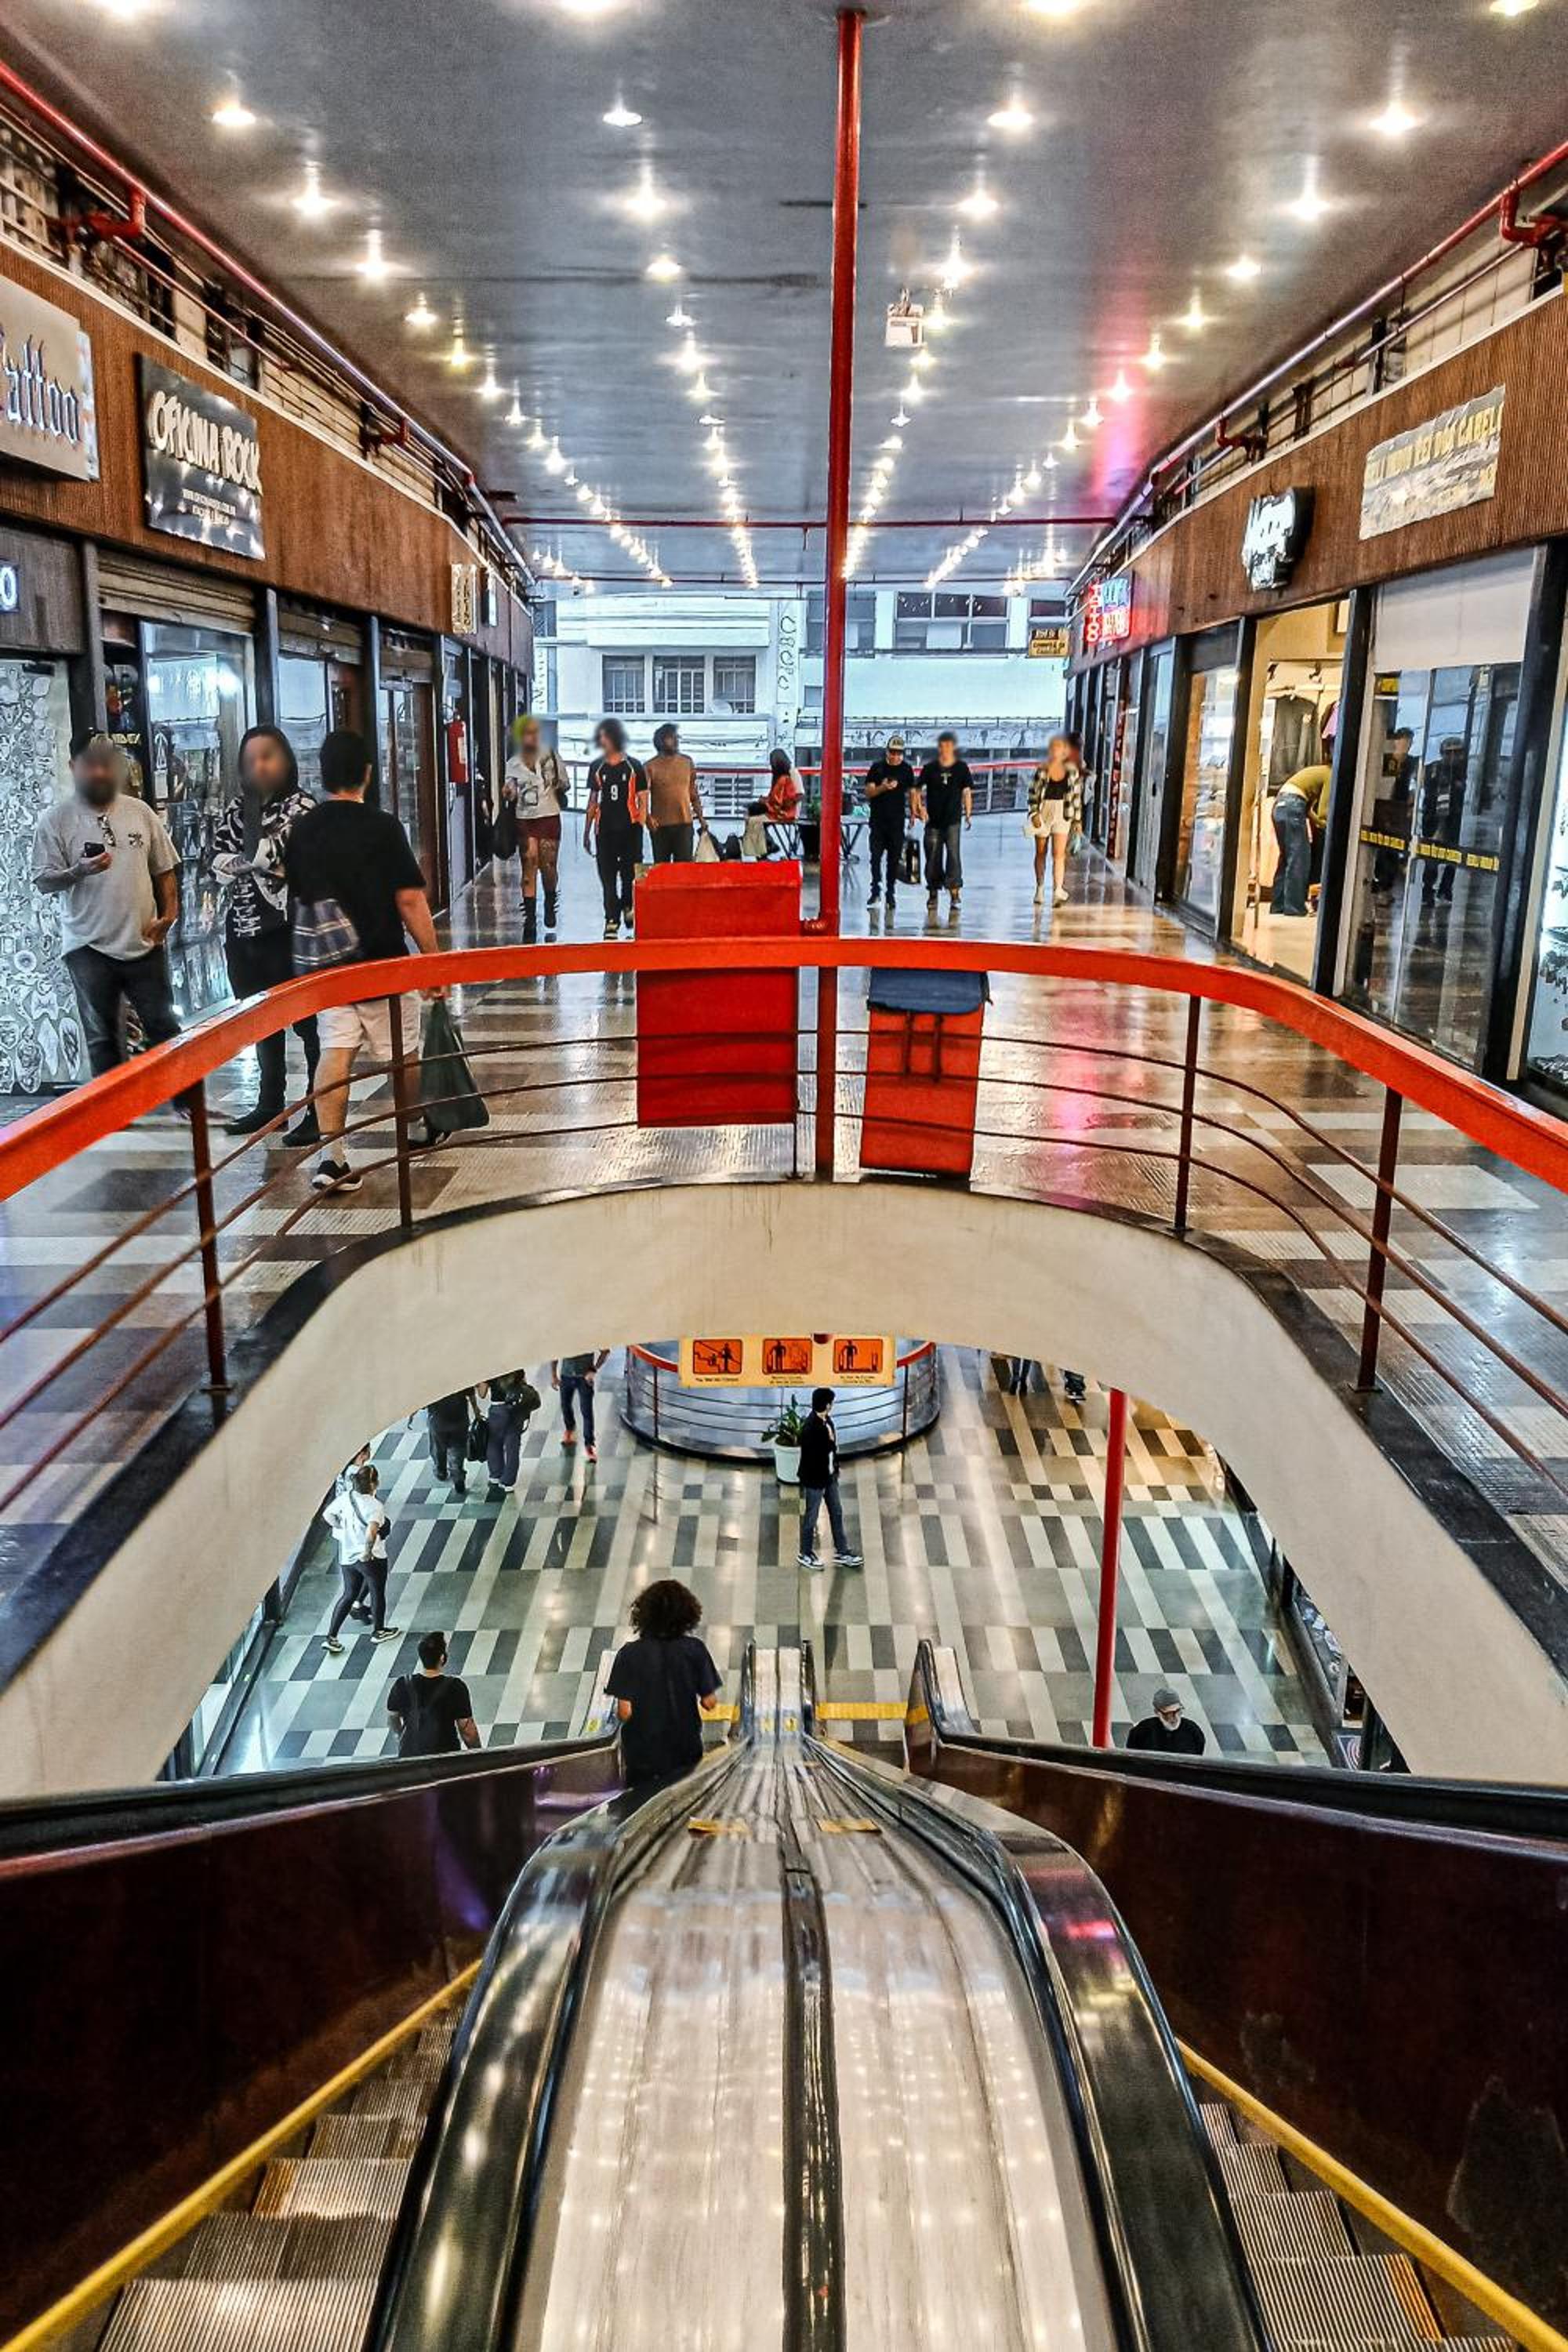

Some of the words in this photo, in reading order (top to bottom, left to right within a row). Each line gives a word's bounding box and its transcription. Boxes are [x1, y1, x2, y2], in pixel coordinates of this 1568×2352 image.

[148, 390, 220, 474] OFICINA
[220, 425, 263, 496] ROCK
[611, 784, 619, 800] 9
